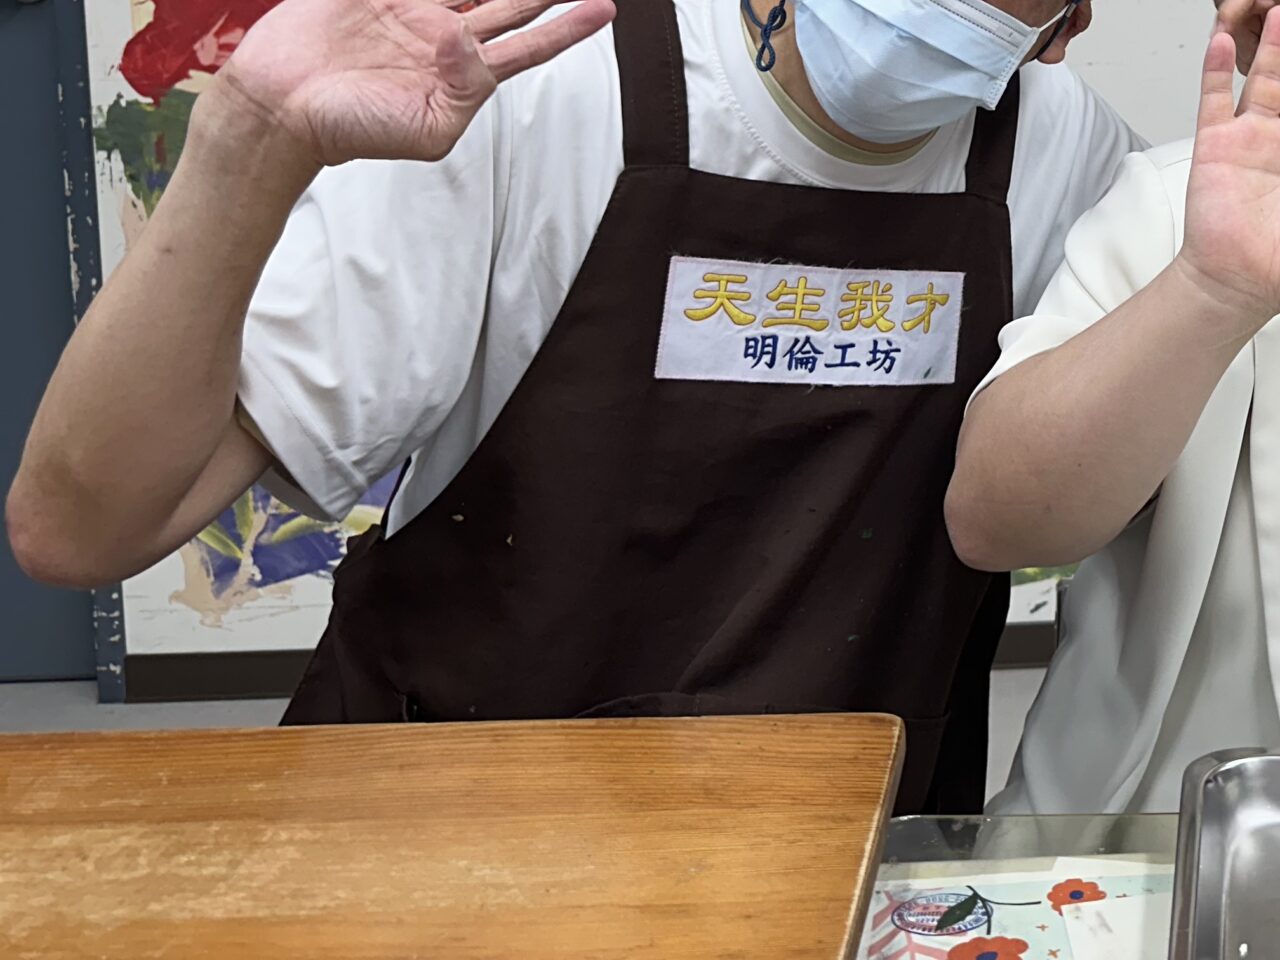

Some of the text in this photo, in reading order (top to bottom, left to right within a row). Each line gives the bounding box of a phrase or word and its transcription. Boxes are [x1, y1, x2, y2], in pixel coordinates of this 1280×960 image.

[682, 272, 950, 334] 天生我才
[742, 334, 902, 374] 明倫工坊
